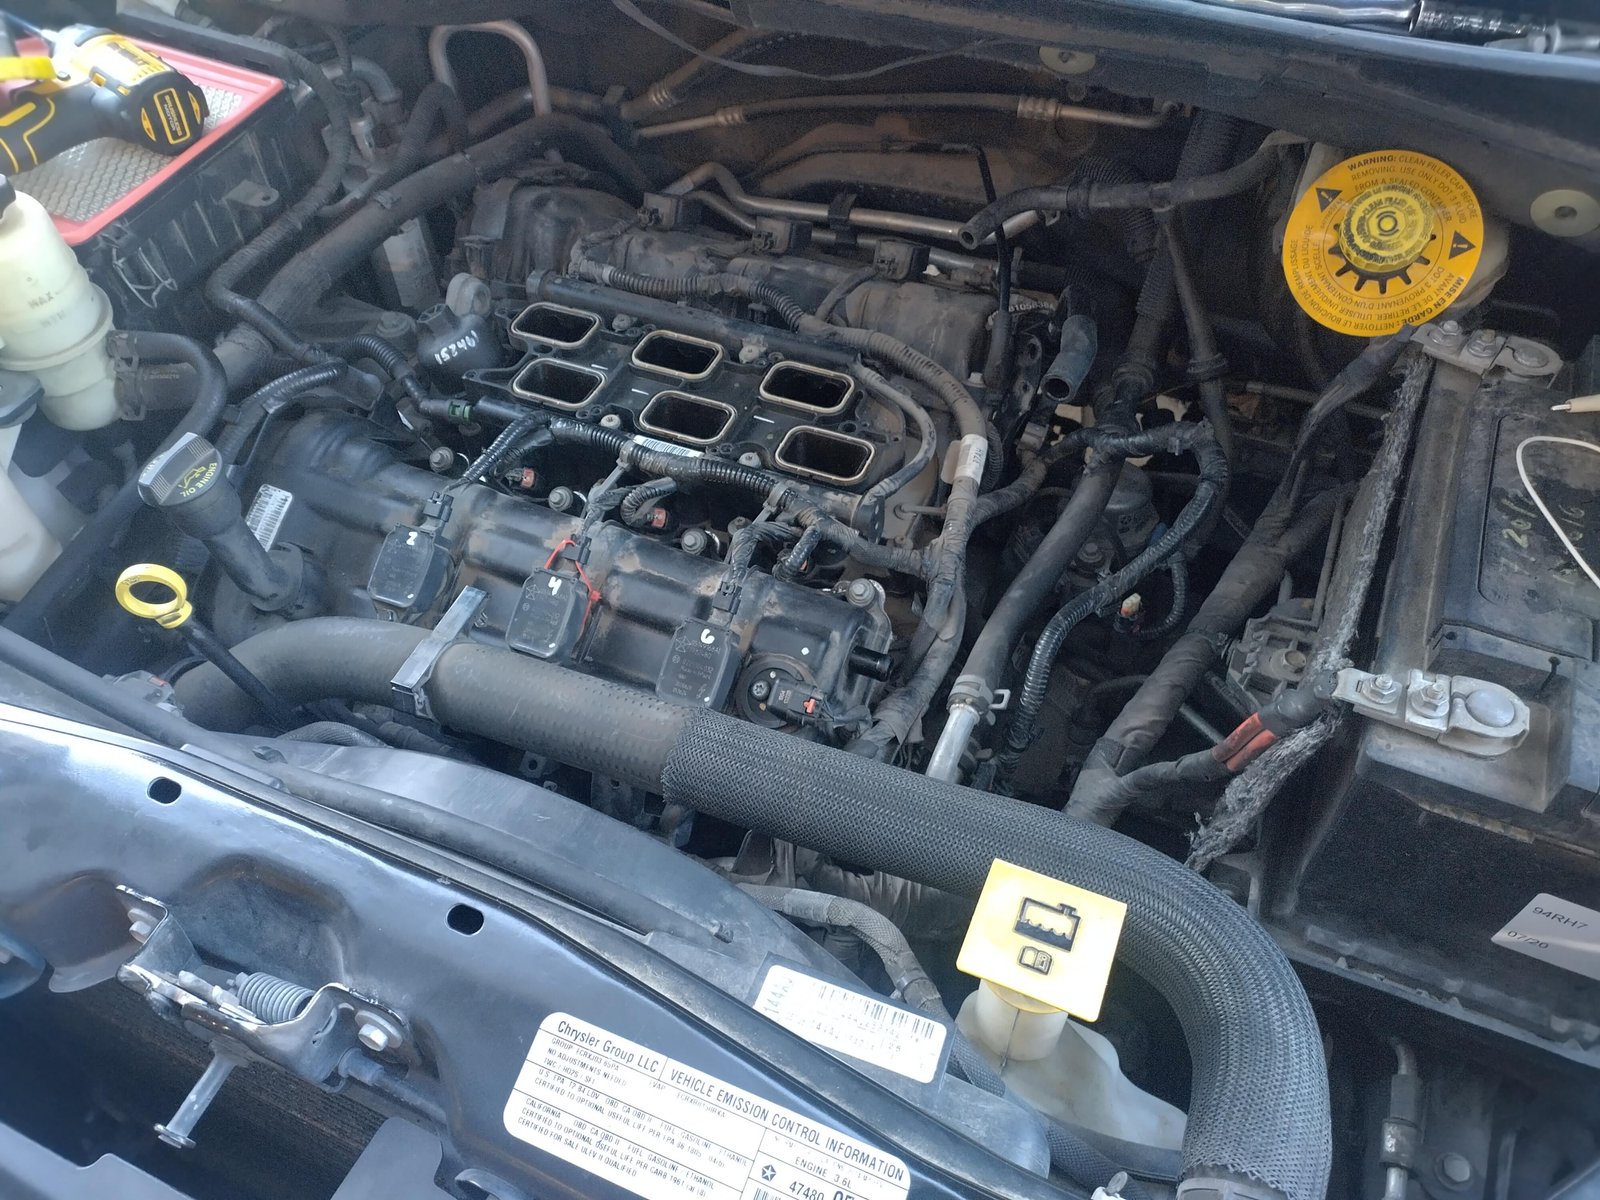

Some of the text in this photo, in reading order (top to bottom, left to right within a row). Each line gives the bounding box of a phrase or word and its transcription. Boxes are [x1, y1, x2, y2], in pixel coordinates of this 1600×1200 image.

[1347, 155, 1477, 219] WARNING: CLEAN FILLER CAP BEFORE
[1353, 178, 1378, 192] FROM
[1399, 166, 1416, 175] USE
[1416, 169, 1438, 184] ONLY
[1437, 181, 1452, 196] DOT
[1289, 239, 1305, 289] REMPLISSAGE
[1429, 266, 1445, 282] DOT
[1300, 289, 1311, 300] DE
[1432, 272, 1455, 296] AVANT
[1444, 276, 1464, 298] MISE
[1377, 286, 1425, 309] PROVENANT
[1410, 302, 1421, 312] LE
[1421, 294, 1433, 305] DE
[1433, 296, 1446, 309] EN
[1307, 298, 1342, 324] BOUCHON
[1341, 319, 1352, 327] LE
[1352, 321, 1394, 330] NETTOYER
[180, 462, 218, 497] ENGINE OIL
[547, 576, 562, 596] 4
[700, 628, 715, 644] 6
[1532, 906, 1588, 929] 94RH7
[1507, 930, 1549, 949] 07/20
[547, 1047, 557, 1056] NO
[557, 1051, 601, 1075] ADJUSTMENTS
[533, 1077, 565, 1096] CERTIFIED
[566, 1091, 575, 1100] TO
[575, 1095, 606, 1114] OPTIONAL
[647, 1128, 661, 1138] PER
[556, 1019, 601, 1048] Chrysler
[601, 1039, 636, 1064] Group
[636, 1054, 659, 1073] LLC
[668, 1068, 714, 1097] VEHICLE
[715, 1088, 770, 1121] EMISSION
[770, 1112, 824, 1145] CONTROL
[824, 1136, 905, 1181] INFORMATION
[516, 1116, 549, 1136] CERTIFIED
[548, 1130, 563, 1142] FOR
[562, 1137, 579, 1149] SALE
[520, 1106, 553, 1126] CERTIFIED
[553, 1121, 562, 1130] TO
[562, 1125, 594, 1145] OPTIONAL
[635, 1159, 649, 1170] PER
[646, 1153, 679, 1173] GASOLINE
[794, 1156, 828, 1177] ENGINE
